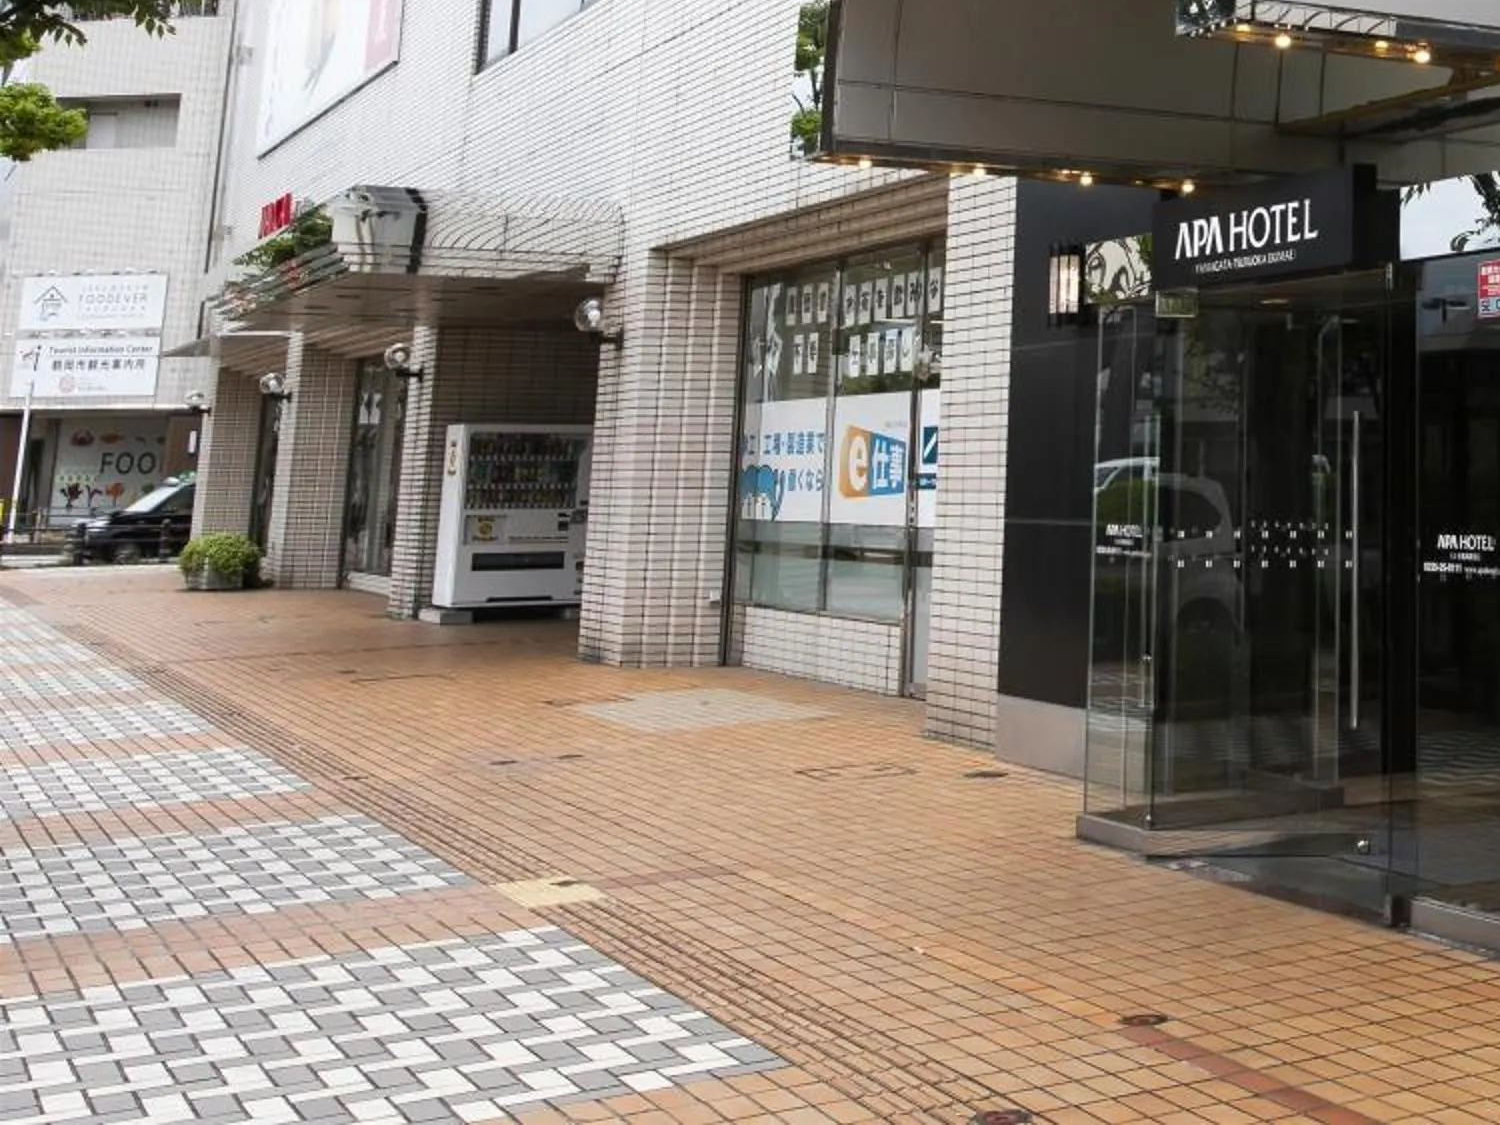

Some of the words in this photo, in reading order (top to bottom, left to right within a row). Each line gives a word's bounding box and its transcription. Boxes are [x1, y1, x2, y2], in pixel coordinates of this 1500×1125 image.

[1175, 216, 1224, 259] APA
[1229, 198, 1319, 252] HOTEL
[50, 346, 76, 355] Tourist
[78, 345, 124, 355] Information
[126, 345, 153, 355] Center
[100, 451, 162, 475] FOO
[1437, 534, 1458, 549] APA
[1460, 534, 1495, 551] HOTEL
